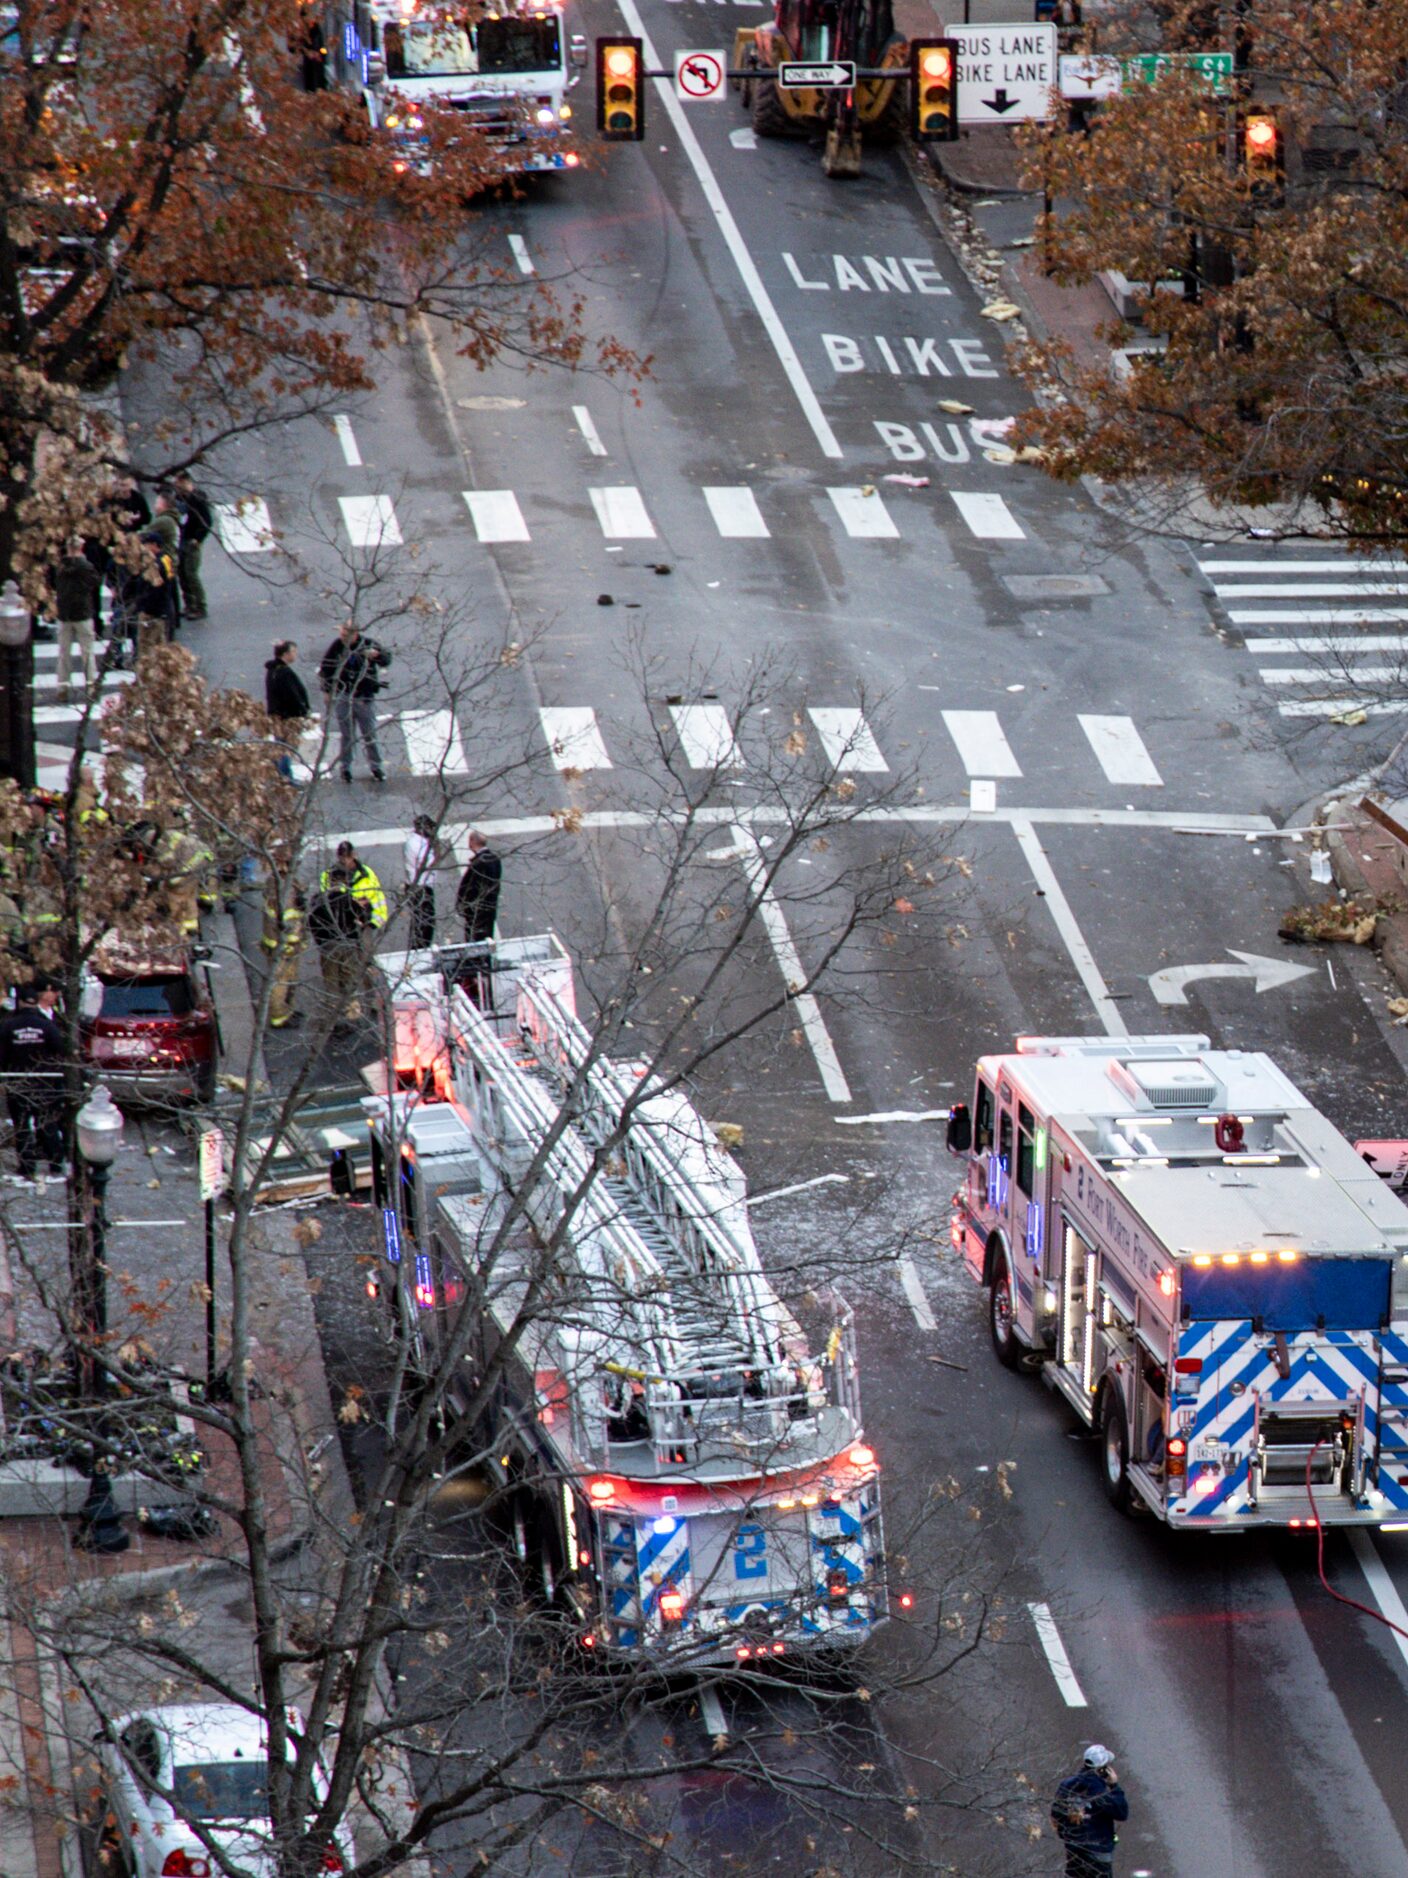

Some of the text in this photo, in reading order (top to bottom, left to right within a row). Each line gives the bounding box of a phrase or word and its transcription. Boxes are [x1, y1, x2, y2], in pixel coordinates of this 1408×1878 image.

[957, 36, 1045, 57] BUS LANE
[787, 70, 831, 80] ONE WAY
[955, 63, 1048, 83] BIKE LANE
[782, 252, 952, 295] LANE
[821, 333, 999, 379] BIKE
[873, 420, 1019, 466] BUS
[734, 1524, 768, 1580] 2
